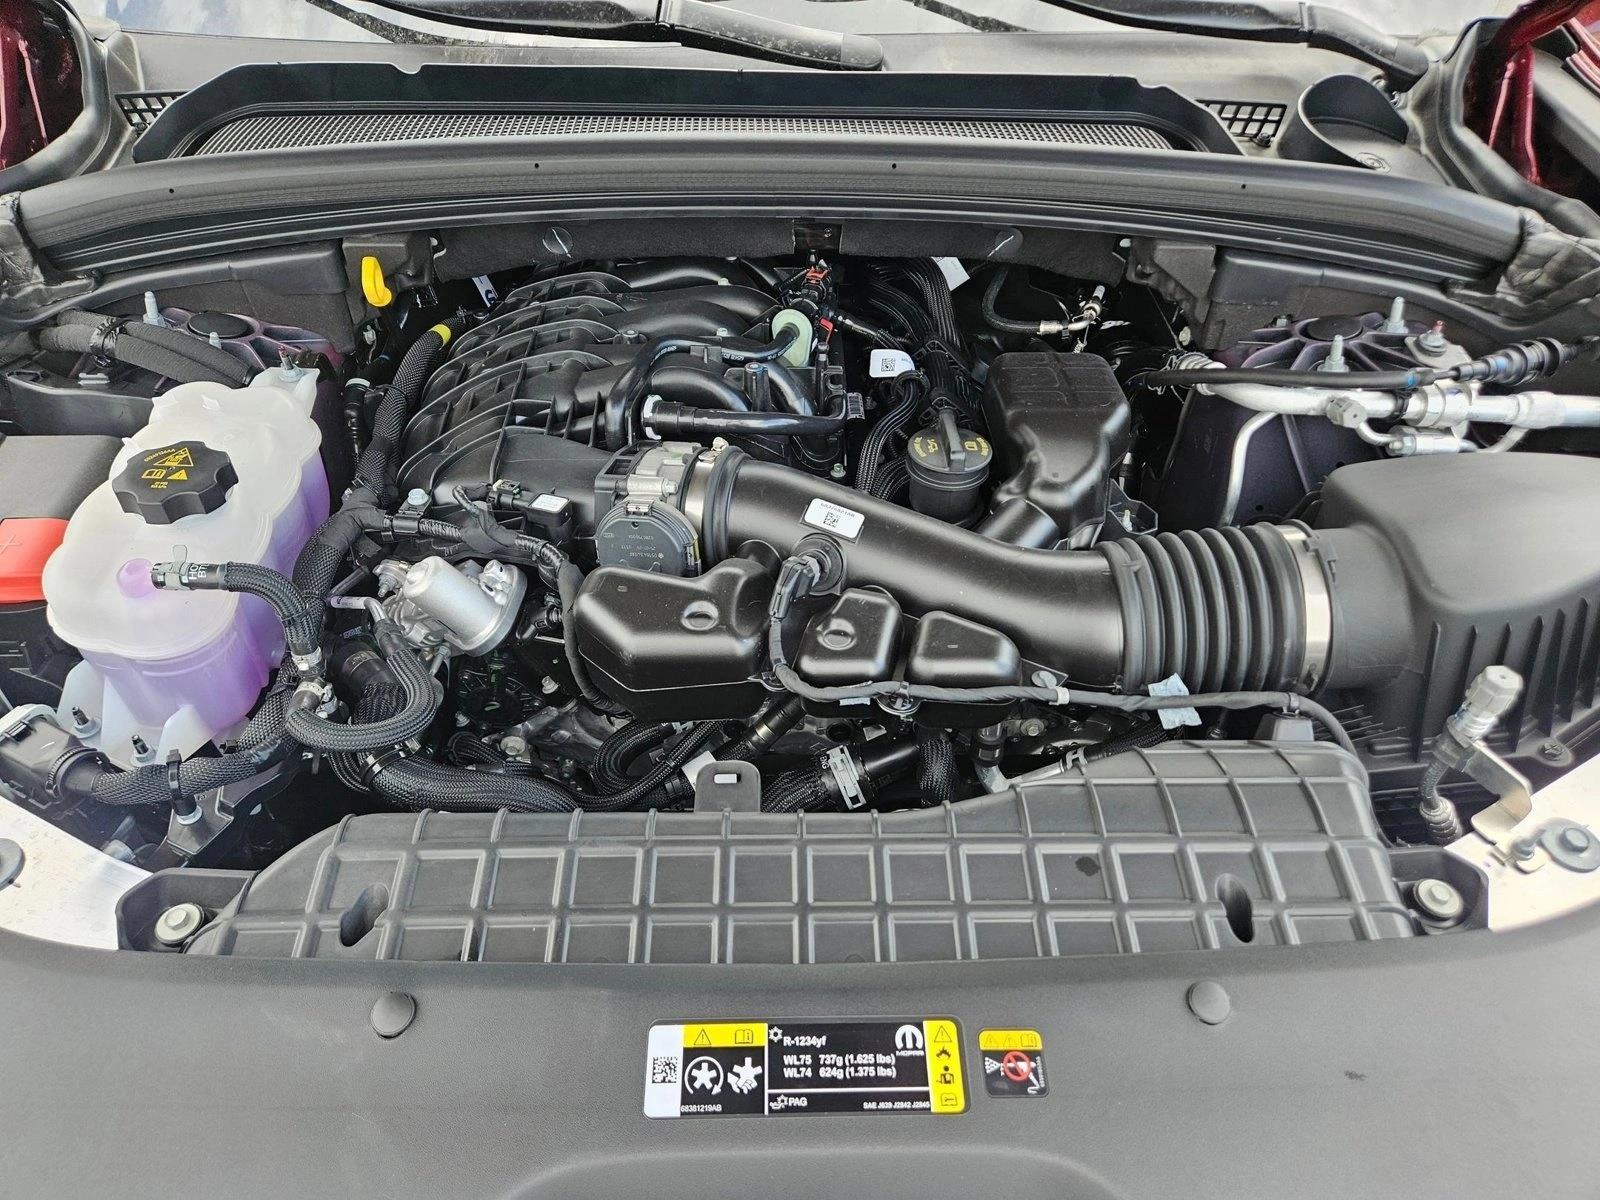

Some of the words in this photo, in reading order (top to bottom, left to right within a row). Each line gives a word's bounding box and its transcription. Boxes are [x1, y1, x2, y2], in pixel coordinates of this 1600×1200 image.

[783, 1035, 827, 1049] R-1234yf
[783, 1054, 812, 1066] WL75
[818, 1053, 844, 1067] 737g
[844, 1053, 875, 1067] (1.625
[876, 1053, 896, 1066] lbs)
[783, 1067, 813, 1078] WL74
[819, 1066, 844, 1080] 624g
[845, 1066, 876, 1079] (1.375
[876, 1066, 897, 1079] lbs)
[788, 1096, 808, 1107] PAG
[862, 1101, 878, 1109] SAE
[680, 1103, 722, 1113] 68381219AB
